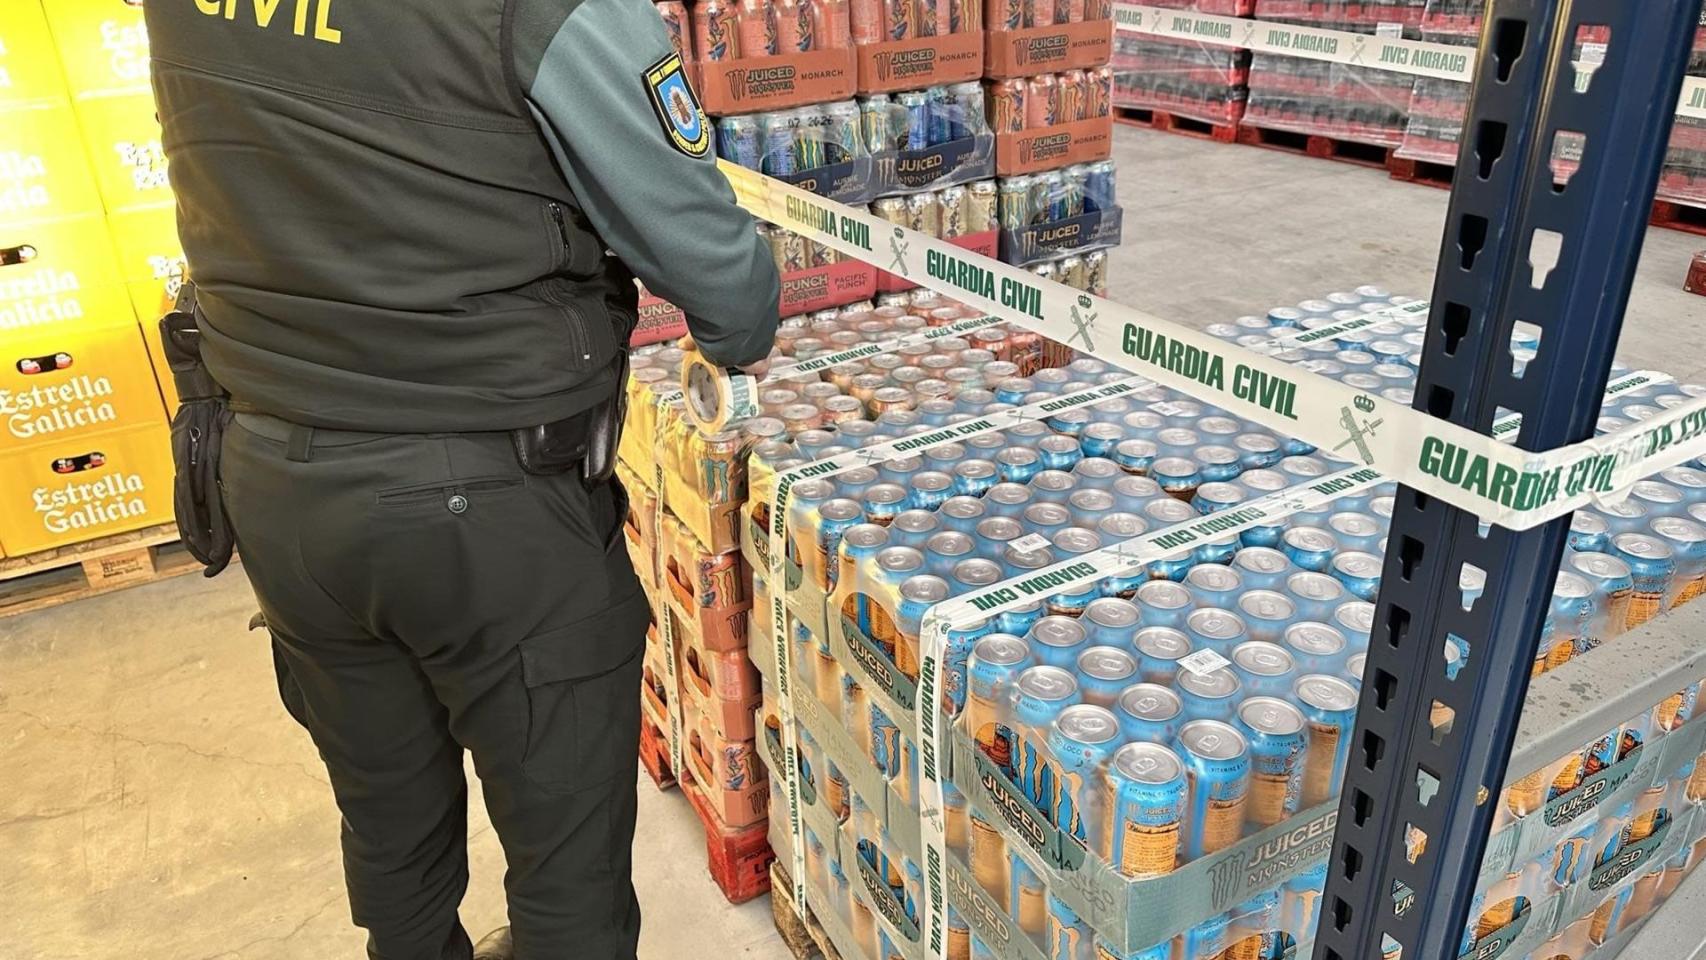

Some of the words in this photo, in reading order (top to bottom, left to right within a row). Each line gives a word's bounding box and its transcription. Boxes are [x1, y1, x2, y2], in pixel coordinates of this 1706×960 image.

[893, 50, 935, 64] JUICED
[940, 52, 977, 61] MONARCH
[1029, 35, 1069, 49] JUICED
[1072, 39, 1106, 48] MONARCH
[748, 67, 795, 82] JUICED
[801, 70, 844, 80] MONARCH
[1032, 133, 1070, 149] JUICED
[1074, 134, 1107, 145] MONARCH
[898, 154, 943, 172] JUICED
[786, 195, 838, 237] GUARDIA
[841, 216, 872, 251] CIVIL
[1039, 224, 1080, 242] JUICED
[783, 274, 828, 293] PUNCH
[835, 272, 867, 284] PACIFIC
[837, 279, 866, 290] PUNCH
[926, 249, 996, 301] GUARDIA
[1001, 277, 1045, 320] CIVIL
[0, 296, 83, 328] alicia
[1122, 323, 1224, 391] GUARDIA
[1232, 364, 1298, 420] CIVIL
[0, 374, 113, 415] Estrella
[1041, 391, 1101, 412] GUARDIA
[1098, 383, 1135, 398] CIVIL
[8, 401, 117, 438] Galicia
[892, 430, 957, 452] GUARDIA
[956, 420, 996, 435] CIVIL
[799, 461, 843, 478] CIVIL
[1419, 436, 1562, 511] GUARDIA
[1565, 454, 1618, 498] CIVIL
[32, 472, 146, 513] Estrella
[1309, 477, 1355, 496] CIVIL
[44, 496, 147, 534] Galicia
[1190, 506, 1267, 536] GUARDIA
[1148, 531, 1197, 550] CIVIL
[1014, 562, 1098, 595] GUARDIA
[966, 587, 1019, 611] CIVIL
[849, 637, 893, 688] JUICED
[921, 655, 936, 738] GUARDIA
[922, 738, 936, 783] CIVIL
[982, 775, 1045, 845] JUICED
[1552, 779, 1607, 821] JUICED
[1247, 810, 1338, 869] JUICED
[1248, 836, 1333, 887] MONSTER
[927, 843, 943, 915] GUARDIA
[948, 871, 1009, 941] JUICED
[930, 913, 943, 956] CIVIL
